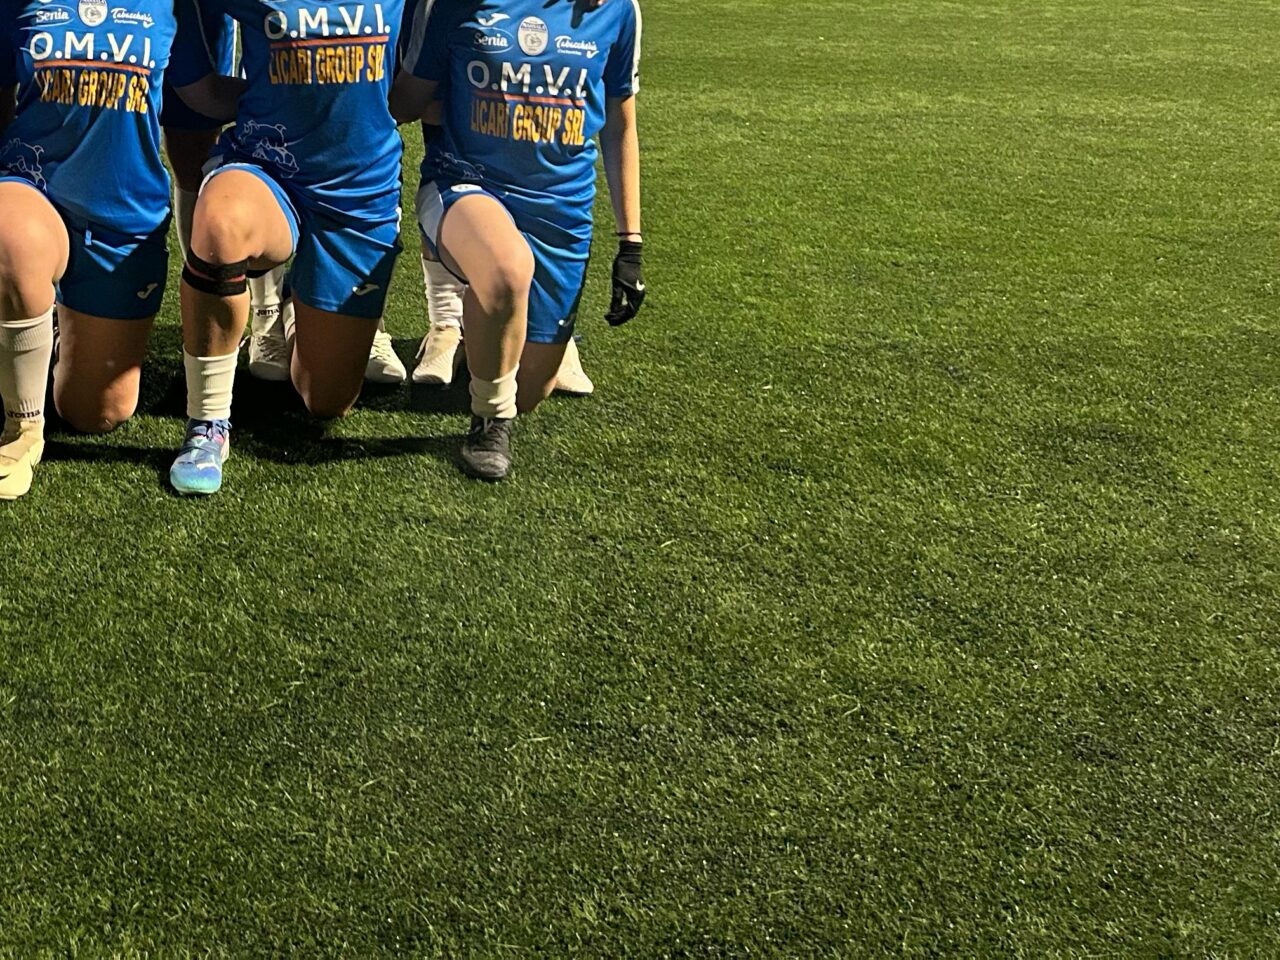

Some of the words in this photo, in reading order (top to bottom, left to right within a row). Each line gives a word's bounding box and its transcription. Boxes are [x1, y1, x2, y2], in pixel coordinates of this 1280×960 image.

[35, 8, 69, 23] Senia
[264, 4, 391, 40] O.M.V.I.
[29, 31, 156, 69] O.M.V.I.
[473, 32, 508, 48] Senia
[315, 45, 365, 84] GROUP
[366, 44, 387, 83] SRL
[466, 60, 588, 98] O.M.V.I.
[78, 70, 127, 111] GROUP
[125, 74, 149, 114] SRL
[471, 98, 510, 139] LICARI
[512, 103, 562, 144] GROUP
[562, 109, 586, 146] SRL
